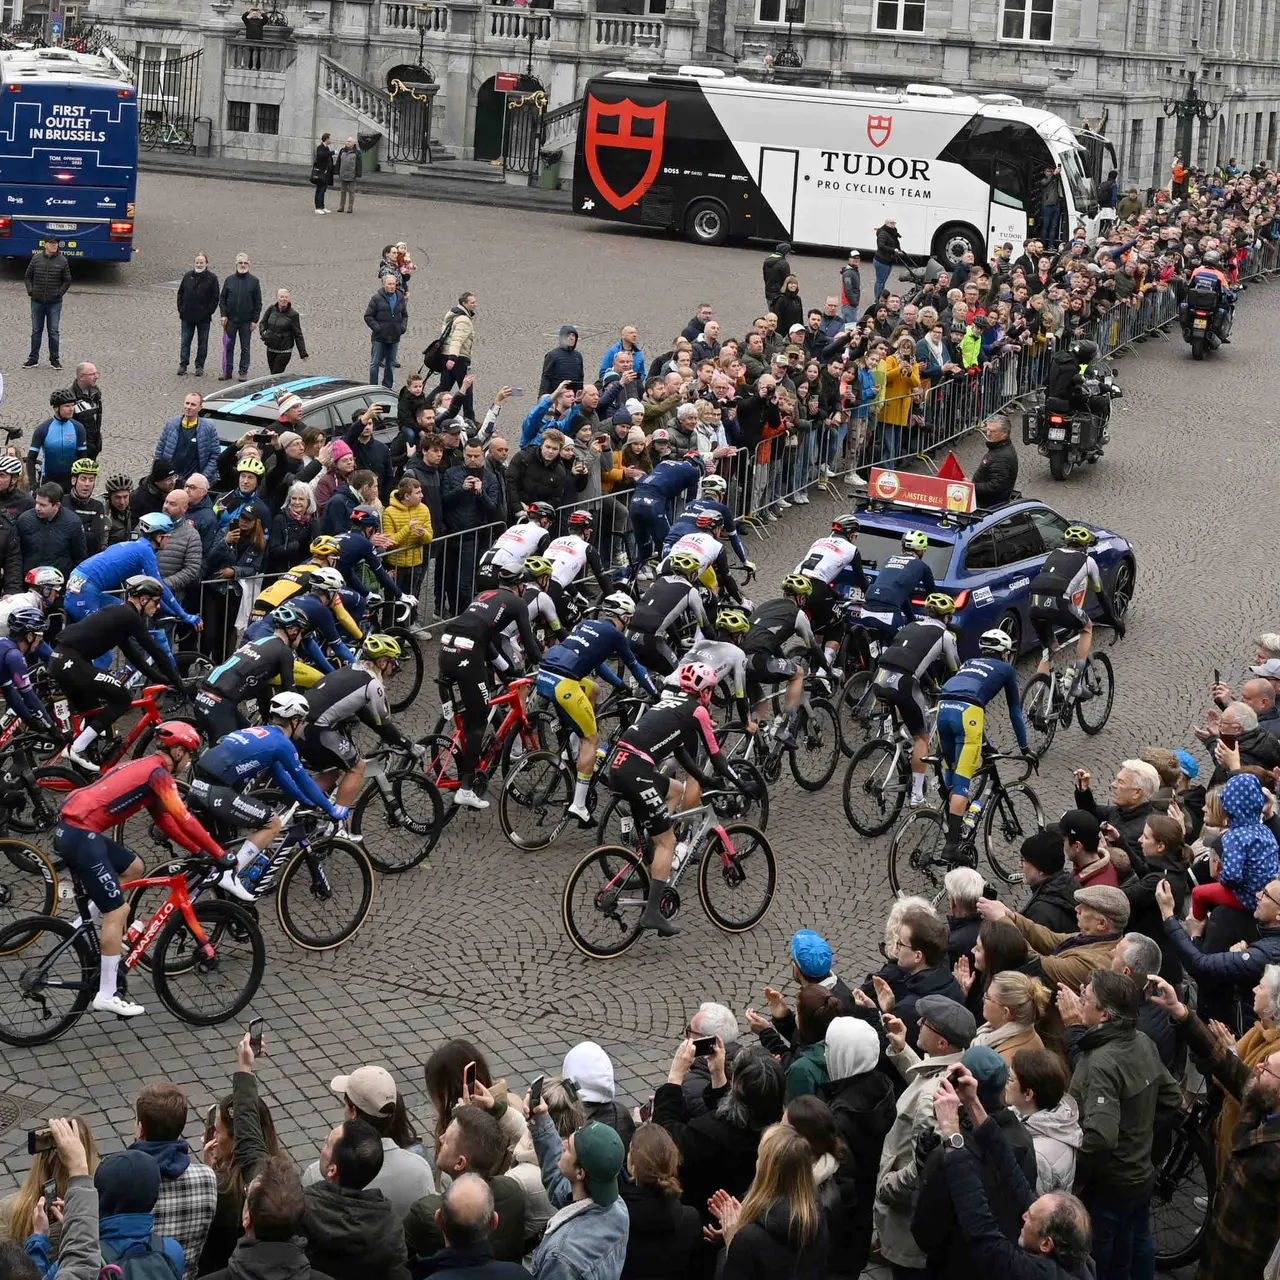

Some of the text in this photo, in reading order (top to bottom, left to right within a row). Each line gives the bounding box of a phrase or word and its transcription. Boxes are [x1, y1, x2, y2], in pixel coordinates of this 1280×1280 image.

[52, 105, 86, 117] FIRST
[45, 117, 91, 129] OUTLET
[29, 128, 106, 142] IN BRUSSELS
[821, 151, 931, 181] TUDOR
[817, 179, 931, 199] PRO CYCLING TEAM
[902, 491, 944, 504] AMSTEL BIER
[1008, 577, 1030, 591] SHIMANO
[974, 589, 991, 600] Boels
[94, 672, 122, 687] BMC
[478, 682, 490, 705] BMC
[650, 729, 681, 753] cannondale
[613, 751, 630, 766] EF
[235, 760, 260, 776] Alpecin
[640, 786, 663, 808] EF
[91, 862, 121, 899] INEOS
[124, 902, 175, 968] PINARELLO
